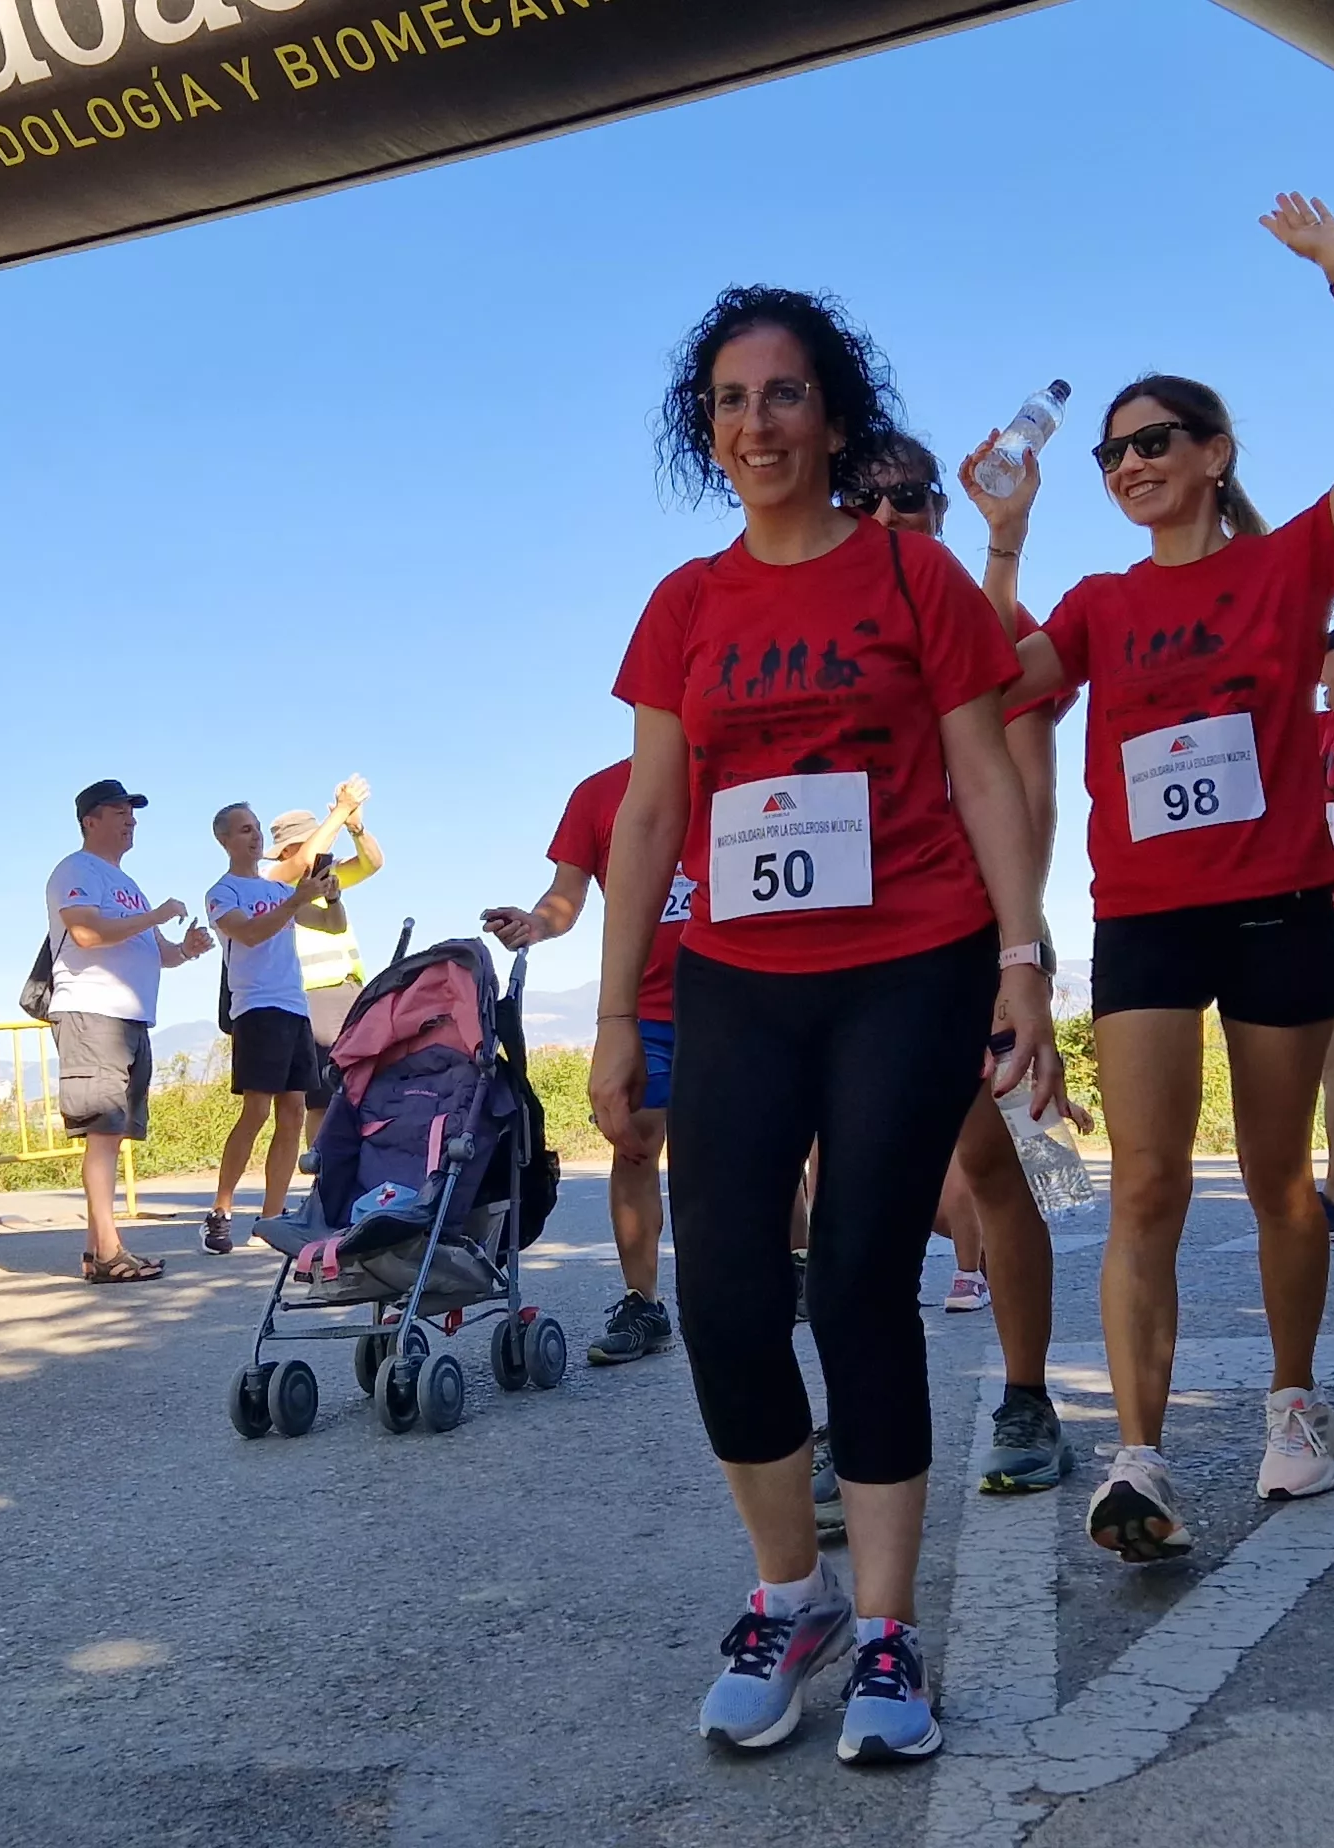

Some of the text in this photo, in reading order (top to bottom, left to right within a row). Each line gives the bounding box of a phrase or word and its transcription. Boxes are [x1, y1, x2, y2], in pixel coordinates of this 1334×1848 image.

[221, 56, 260, 101] Y
[1163, 778, 1219, 821] 98
[766, 824, 779, 839] POR
[780, 823, 789, 836] LA
[752, 849, 815, 902] 50
